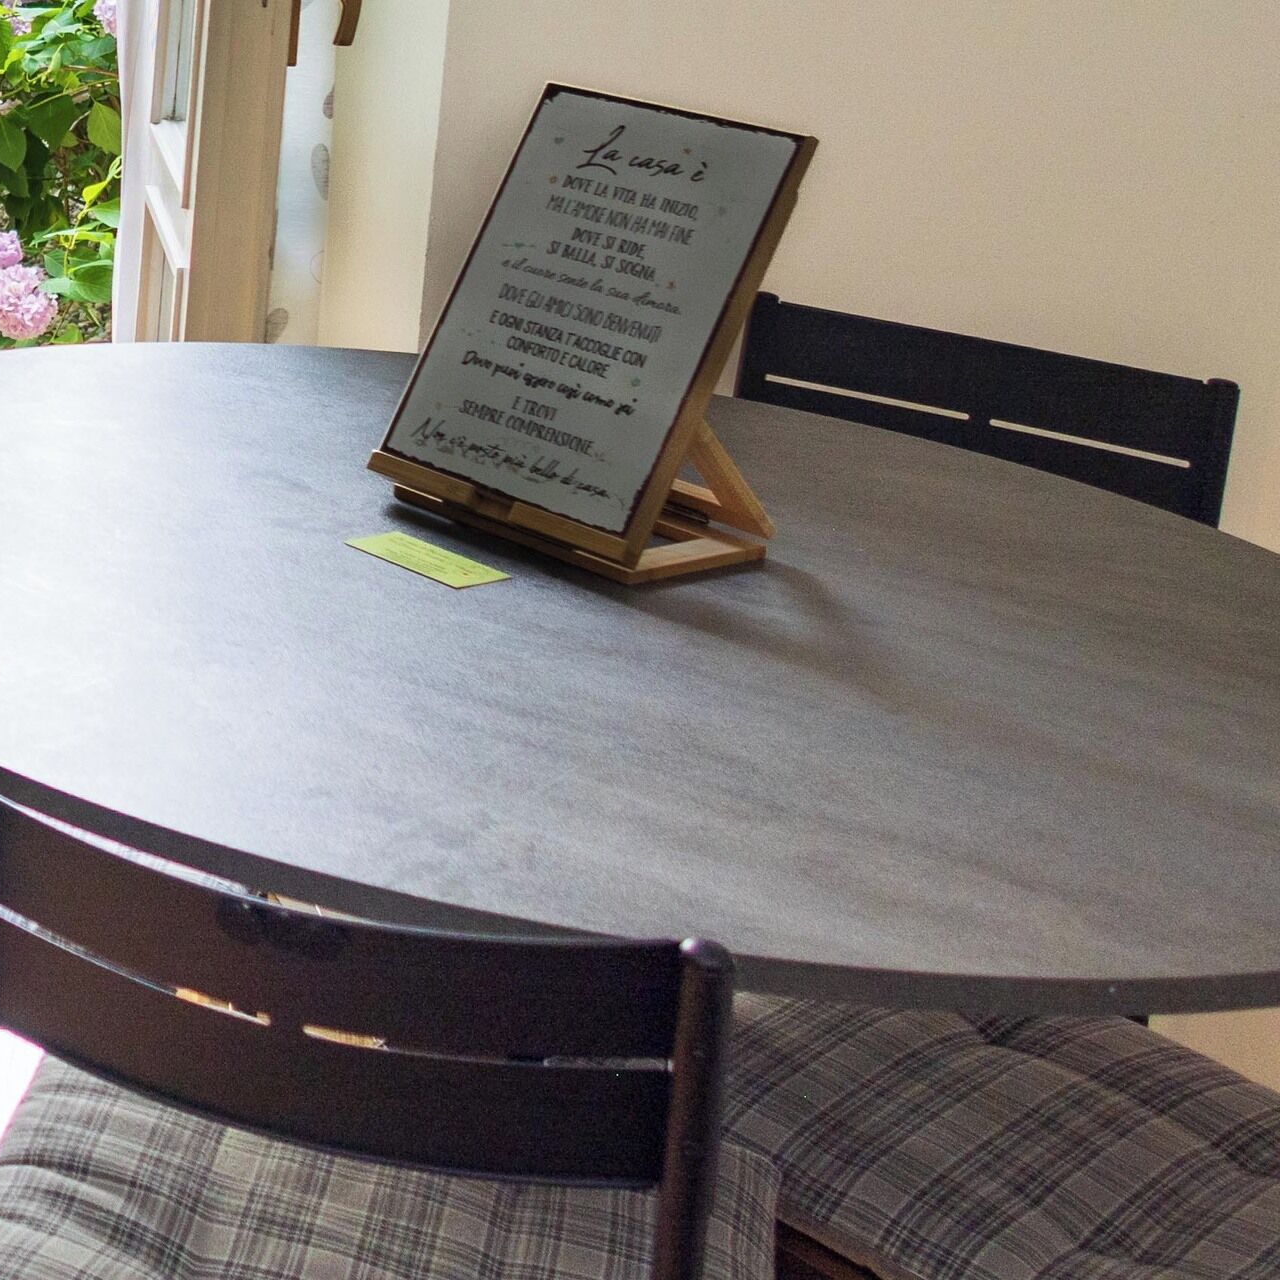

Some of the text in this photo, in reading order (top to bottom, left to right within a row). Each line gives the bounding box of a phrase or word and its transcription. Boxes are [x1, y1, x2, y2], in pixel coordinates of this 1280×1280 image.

[576, 124, 708, 182] La casa è
[561, 174, 595, 194] DOVE
[593, 181, 608, 198] LA
[612, 186, 637, 205] VITA
[641, 193, 657, 210] HA
[546, 194, 565, 211] MA
[607, 210, 629, 230] NON
[629, 214, 647, 234] HA
[646, 218, 669, 239] MAI
[668, 225, 695, 245] FINE
[571, 227, 602, 247] DOVE
[602, 235, 617, 250] SI
[546, 240, 562, 255] SI
[600, 255, 616, 269] SI
[501, 259, 510, 267] e
[511, 258, 528, 270] il
[523, 265, 557, 280] cuore
[557, 273, 589, 289] sente
[590, 279, 604, 293] la
[605, 287, 630, 301] sua
[498, 283, 663, 344] DOVE GLI AMICI SONO BENVENUTI
[489, 309, 500, 324] E
[498, 313, 524, 332] OGNI
[523, 320, 564, 343] STANZA
[622, 349, 648, 369] CON
[506, 336, 611, 379] CONFORTO E CALORE
[461, 350, 493, 370] Dove
[490, 362, 523, 381] puoi
[522, 372, 558, 389] essere
[582, 391, 616, 409] come
[458, 399, 506, 425] SEMPRE
[512, 396, 559, 421] E TROVI
[529, 455, 561, 480] bello
